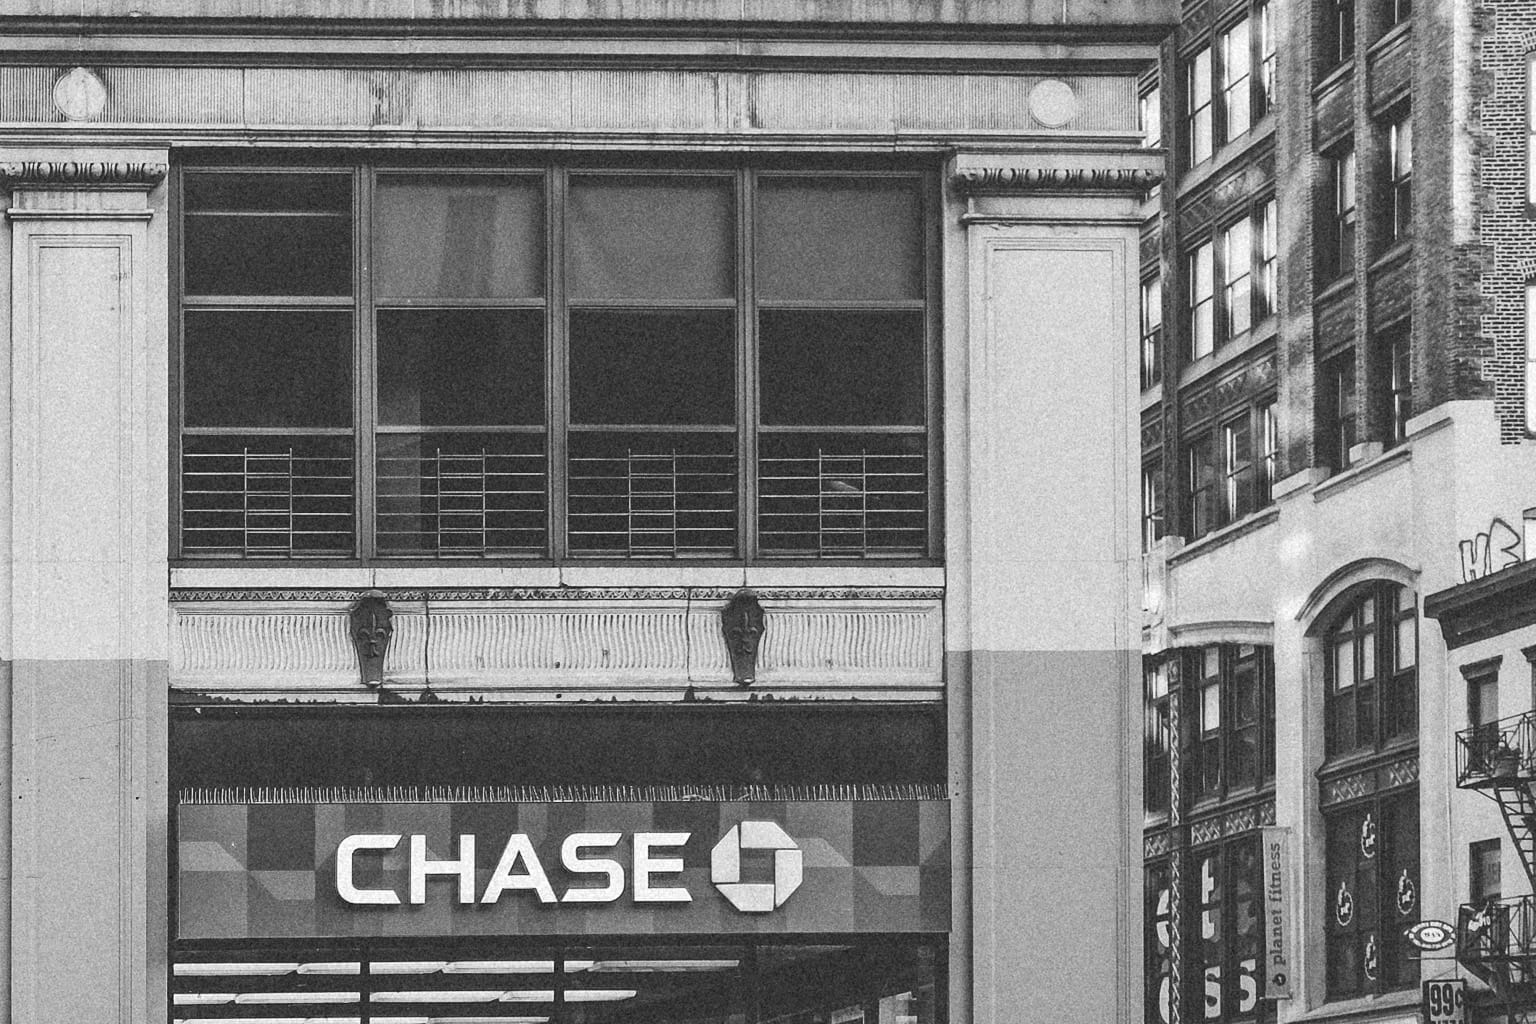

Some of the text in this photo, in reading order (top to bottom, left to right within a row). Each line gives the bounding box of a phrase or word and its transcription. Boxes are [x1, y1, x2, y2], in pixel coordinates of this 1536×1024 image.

[336, 832, 693, 905] CHASE
[1269, 842, 1286, 966] planet fitness
